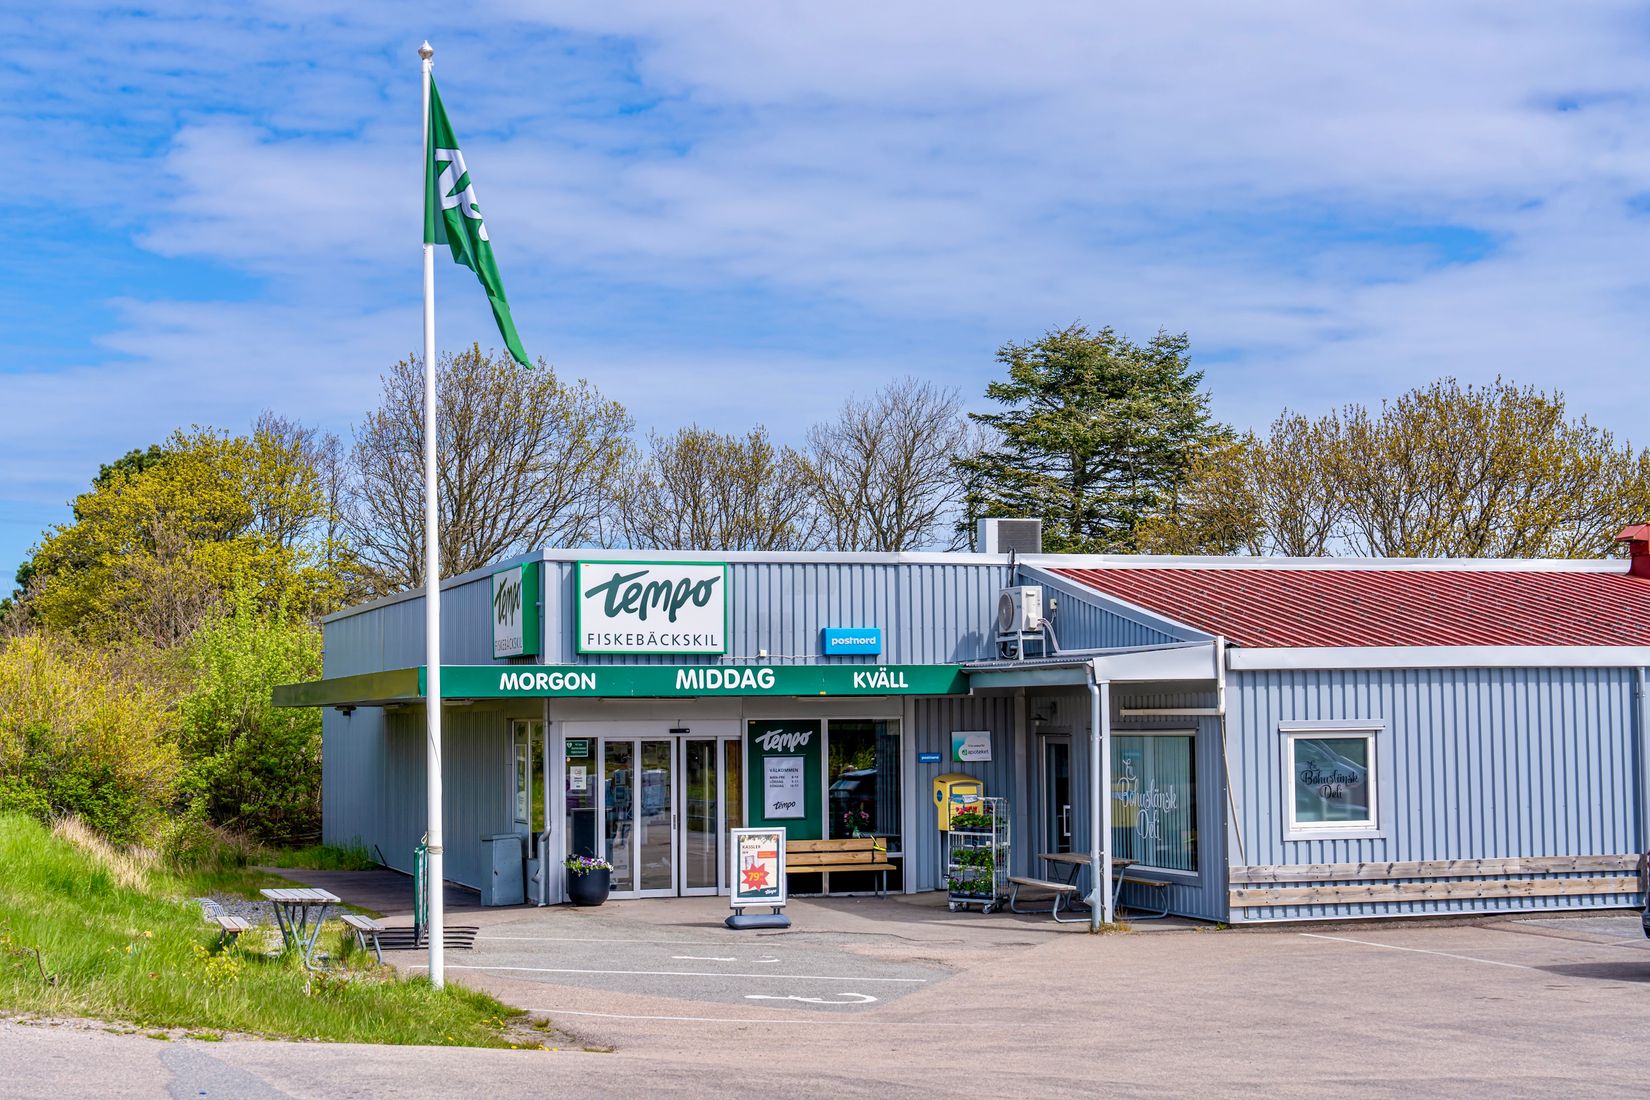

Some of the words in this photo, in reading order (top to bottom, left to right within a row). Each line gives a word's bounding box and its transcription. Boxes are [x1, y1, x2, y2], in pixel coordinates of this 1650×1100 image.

[587, 631, 718, 647] FISKEBÄCKSKIL
[831, 636, 877, 646] postnord
[499, 671, 596, 691] MORGON
[675, 667, 776, 691] MIDDAG
[853, 667, 909, 689] KVÄLL
[1300, 769, 1359, 786] Bohuslänsk
[1117, 776, 1177, 813] Bohuslänsk
[1319, 784, 1343, 799] Deli
[1135, 809, 1162, 841] Deli
